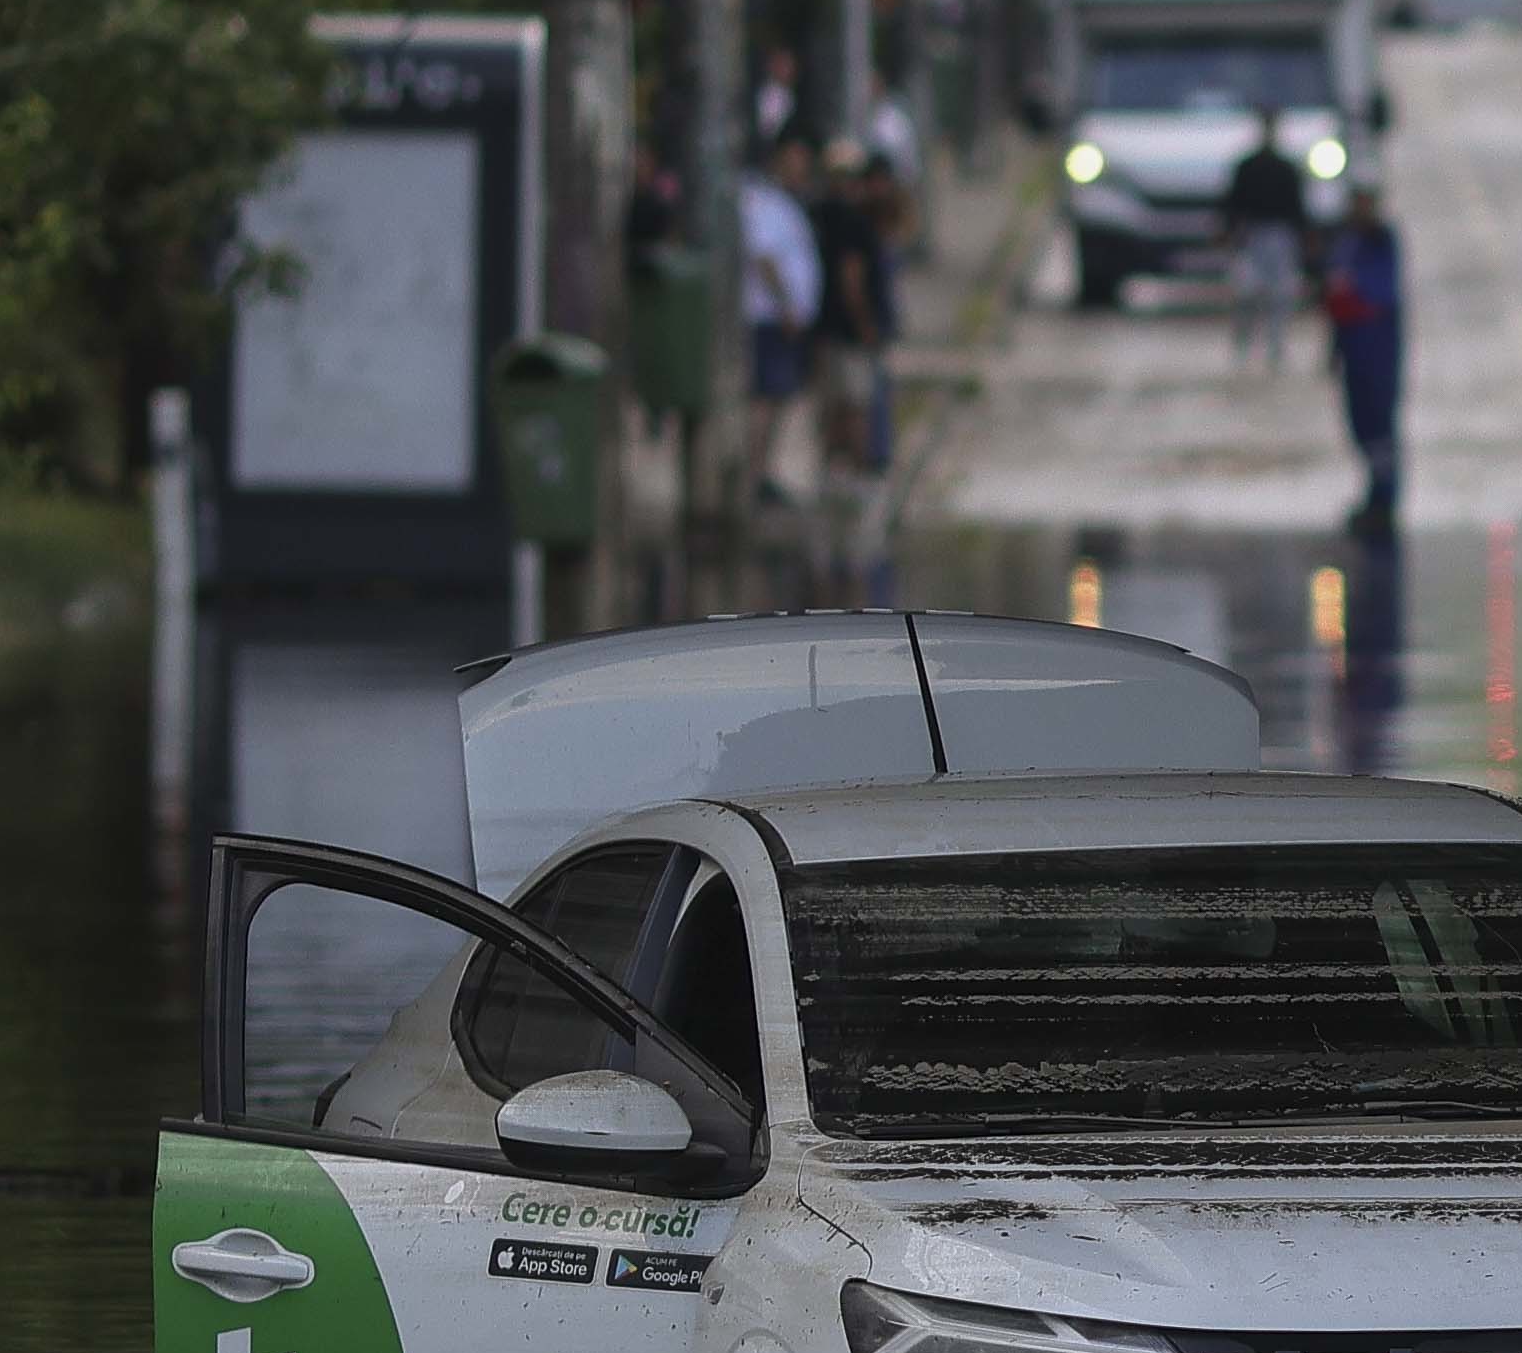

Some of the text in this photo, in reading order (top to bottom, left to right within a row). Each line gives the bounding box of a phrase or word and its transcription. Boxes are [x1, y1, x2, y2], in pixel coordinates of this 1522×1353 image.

[502, 1192, 700, 1239] Cere o cursă!
[564, 1250, 574, 1259] de
[575, 1252, 587, 1261] pe
[645, 1255, 678, 1267] ACUM PE
[518, 1256, 587, 1276] App Store
[642, 1266, 703, 1286] Google Pl
